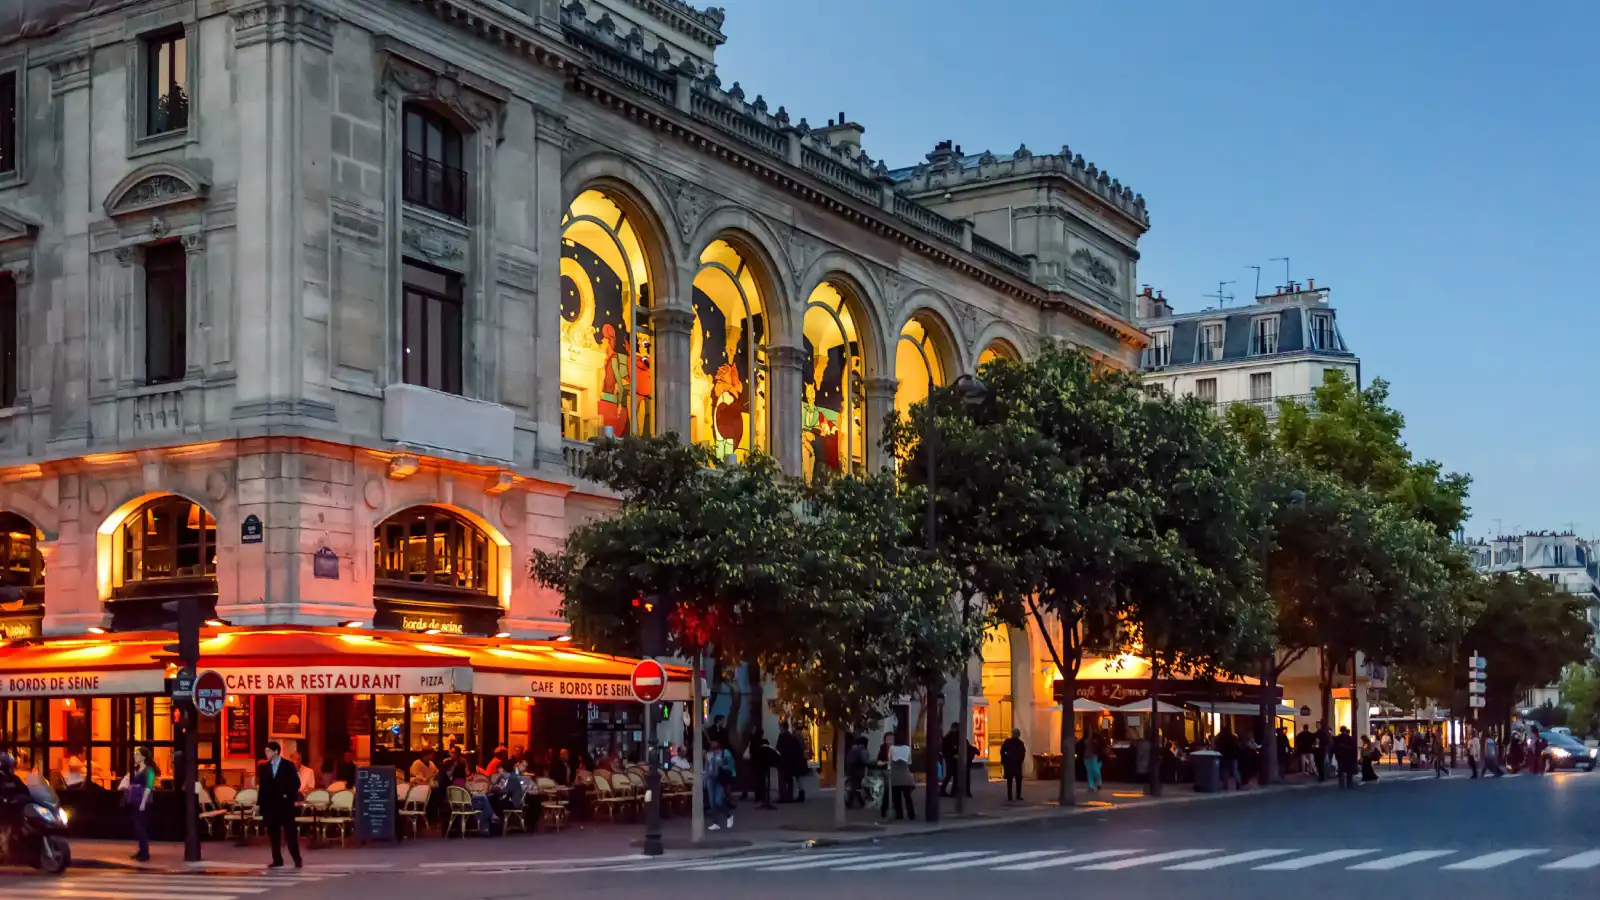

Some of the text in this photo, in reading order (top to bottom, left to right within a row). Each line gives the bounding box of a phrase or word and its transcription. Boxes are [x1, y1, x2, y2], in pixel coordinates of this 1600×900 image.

[402, 616, 464, 634] bords de seine
[9, 678, 47, 692] BORDS
[50, 677, 64, 690] DE
[67, 676, 99, 690] SEINE
[226, 674, 401, 690] CAFE BAR RESTAURANT
[420, 675, 445, 687] PIZZA
[531, 681, 554, 693] CAFE
[559, 682, 593, 695] BORDS
[595, 683, 608, 696] DE
[611, 684, 634, 697] SEIN
